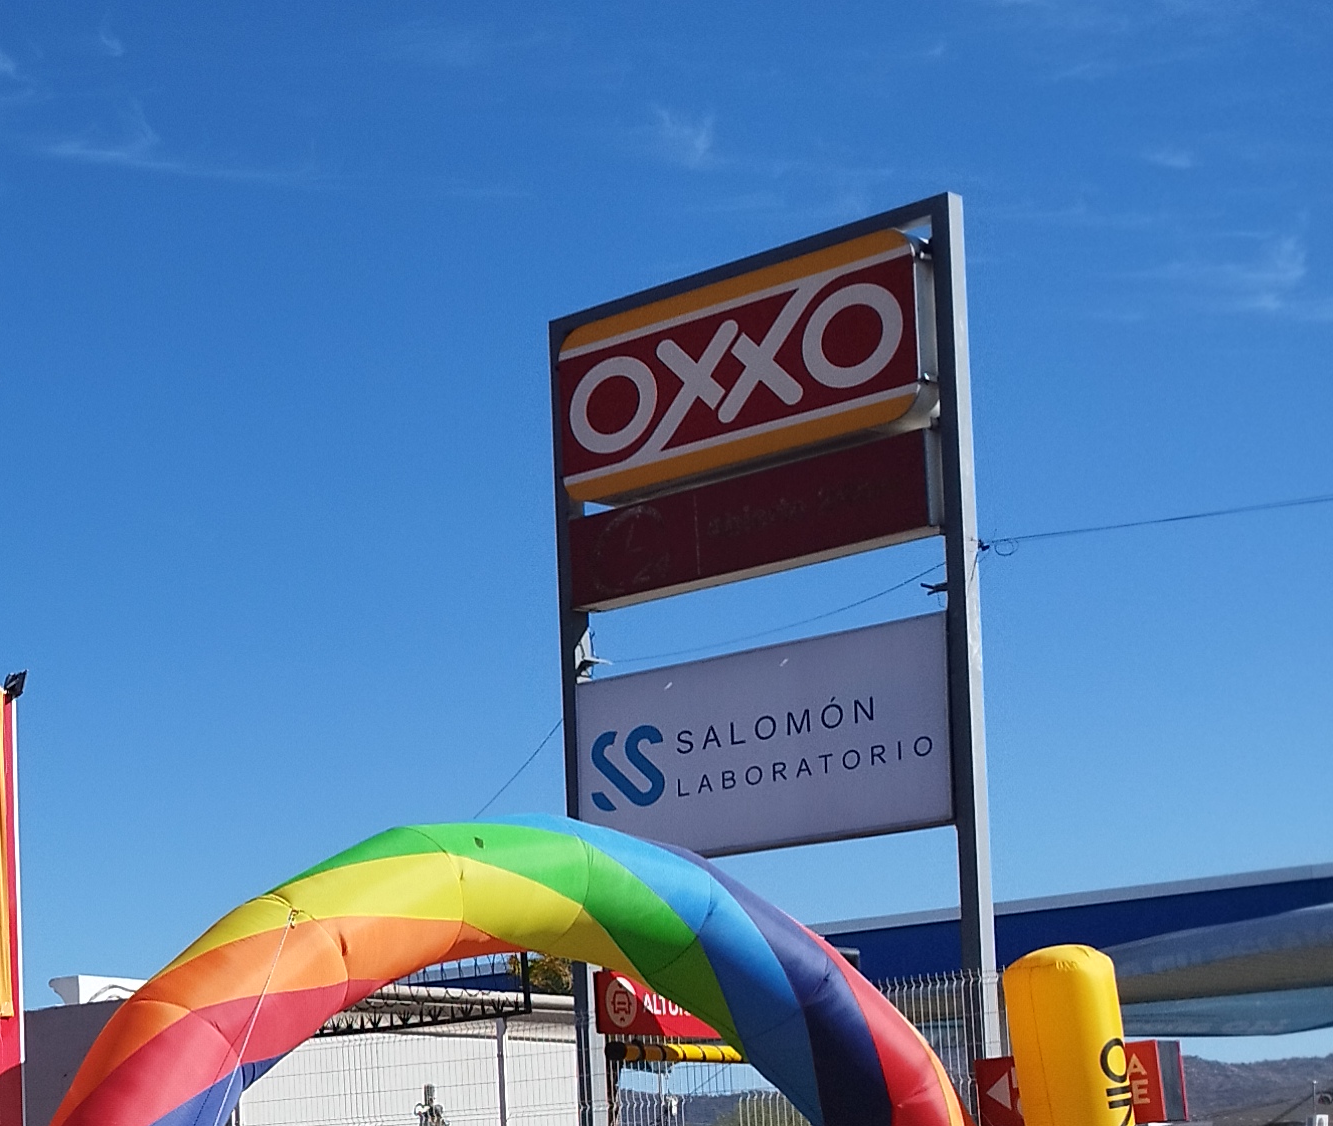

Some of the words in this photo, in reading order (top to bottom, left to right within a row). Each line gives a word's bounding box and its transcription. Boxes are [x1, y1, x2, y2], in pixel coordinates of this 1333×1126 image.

[568, 280, 904, 454] OXXO
[676, 695, 877, 754] SALOMÓN
[676, 734, 935, 798] LABORATORIO
